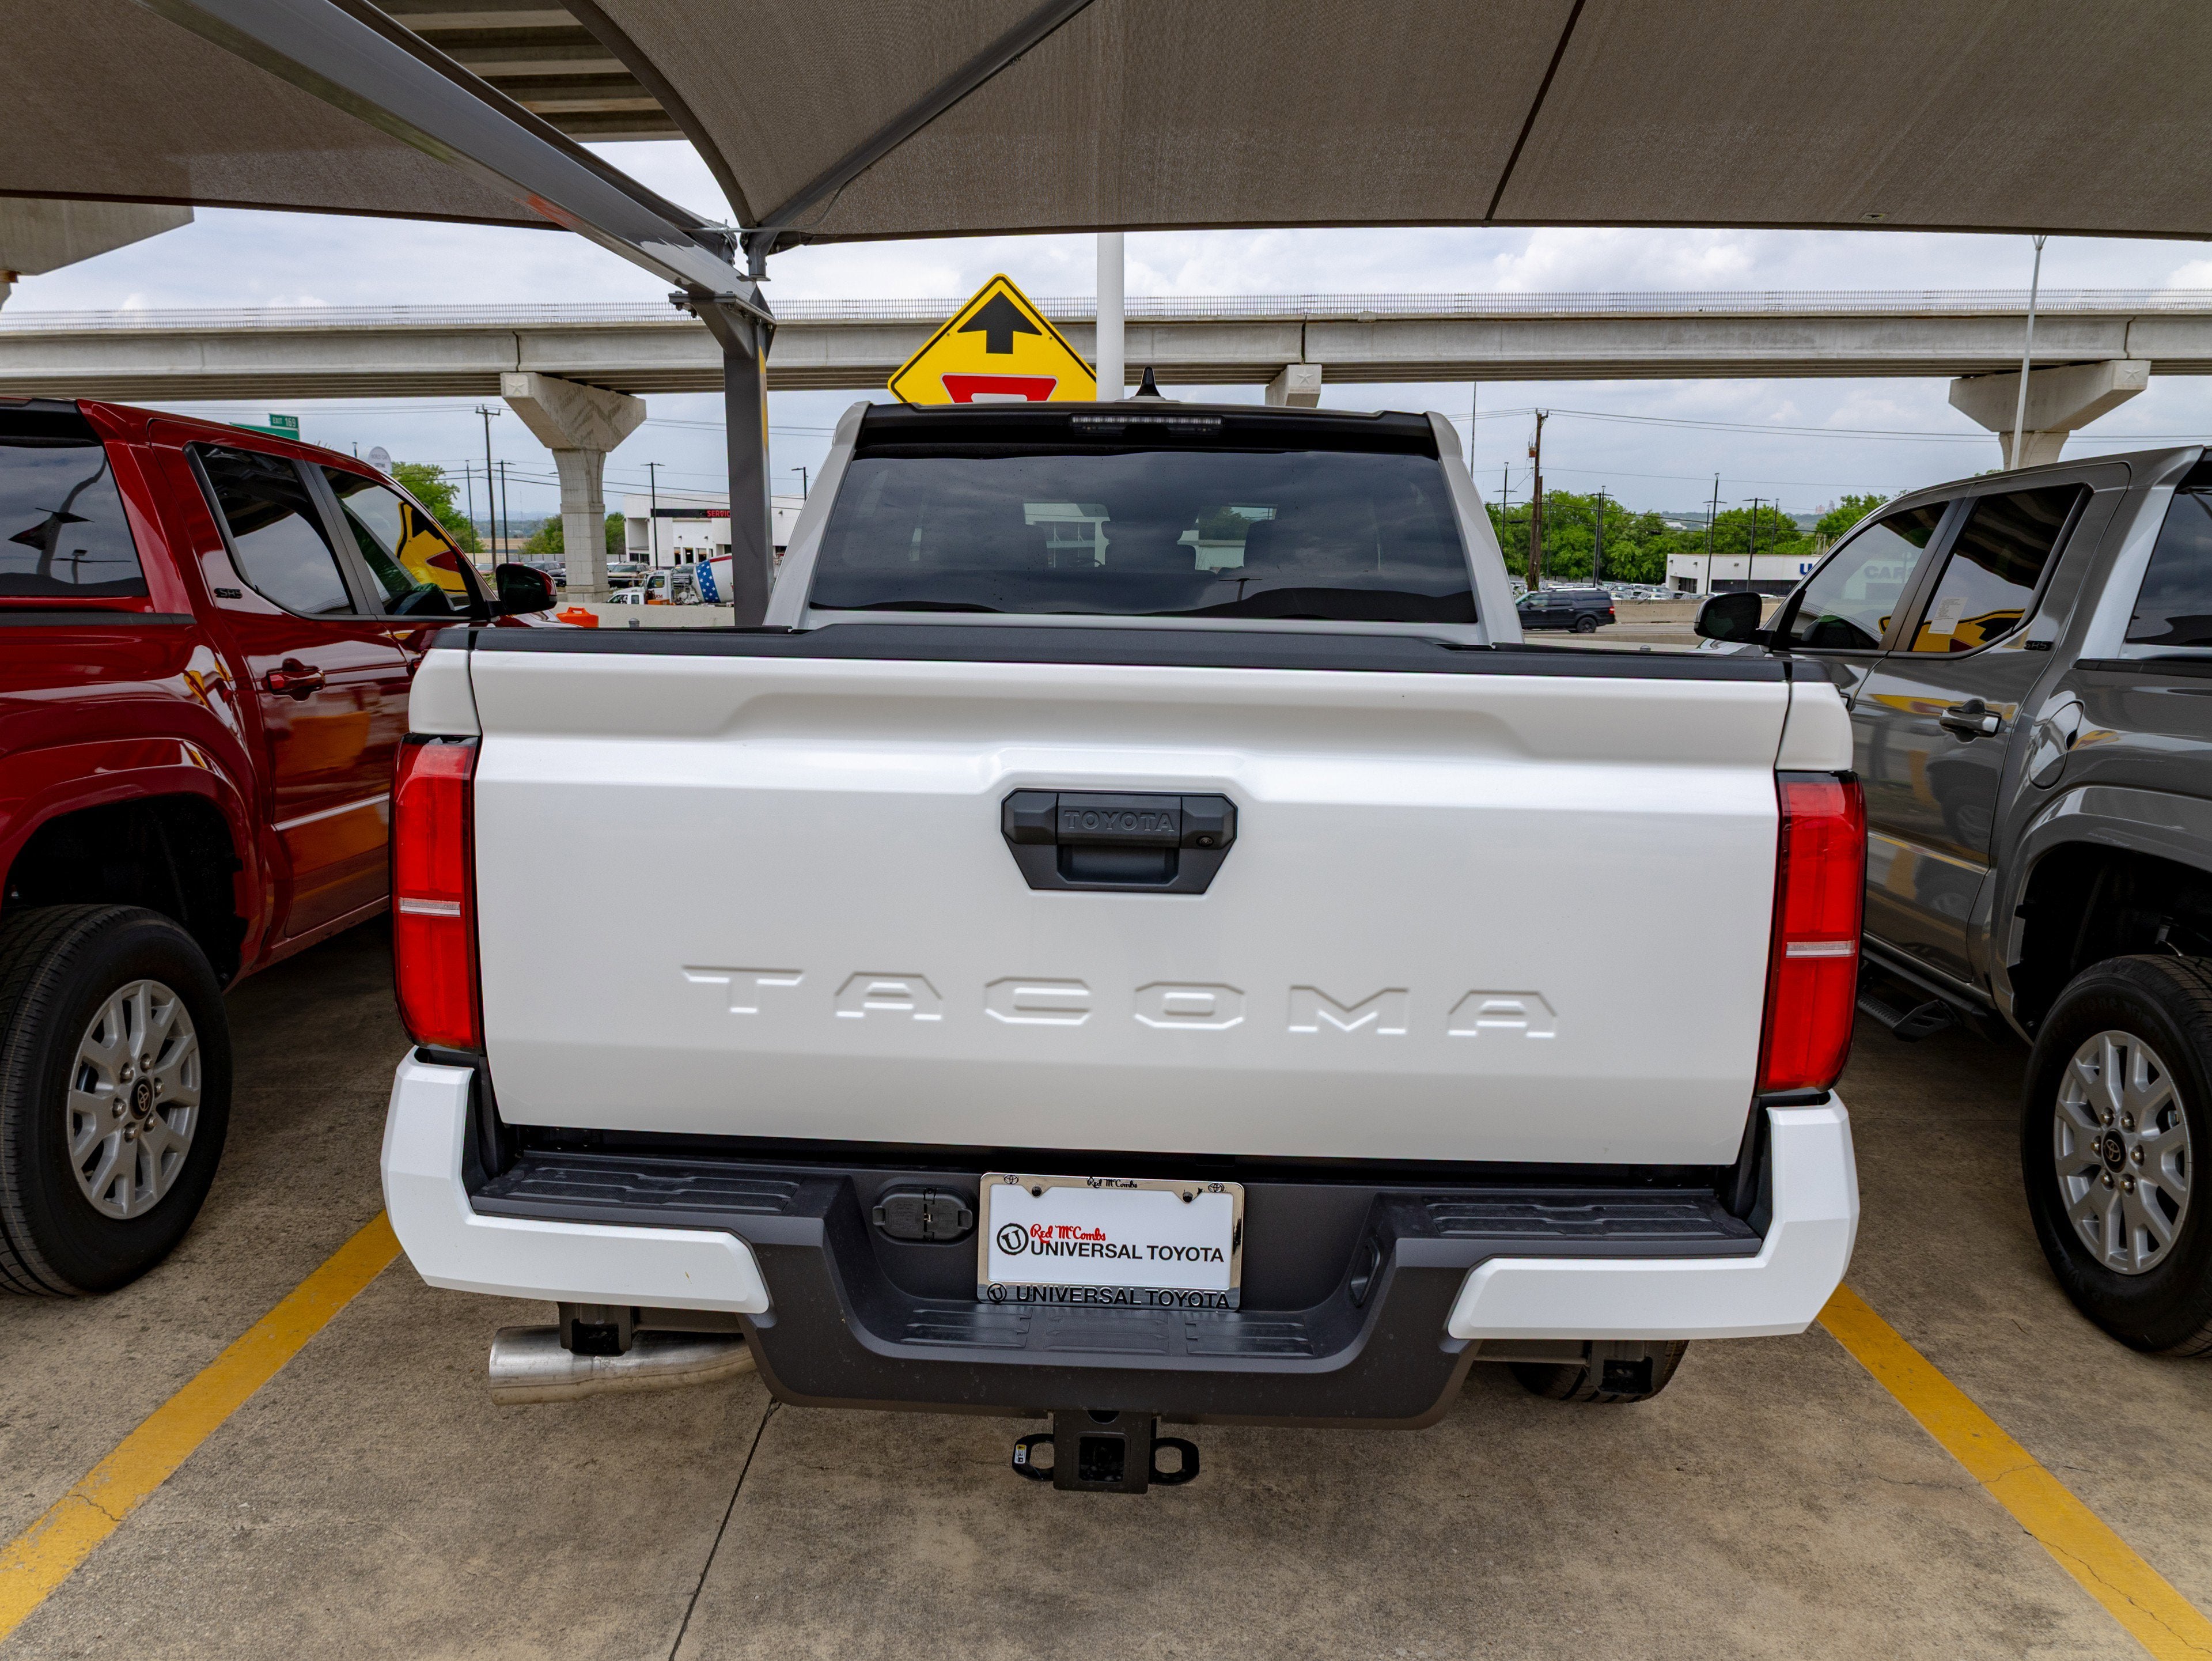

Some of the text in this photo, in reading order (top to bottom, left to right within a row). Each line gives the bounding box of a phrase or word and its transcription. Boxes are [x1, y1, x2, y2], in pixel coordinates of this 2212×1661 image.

[285, 417, 296, 427] 169
[1064, 810, 1175, 832] TOYOTA
[682, 964, 1558, 1039] TACOMA
[1087, 1177, 1137, 1189] Red McCombs
[1030, 1223, 1107, 1244] Red McCombs
[1031, 1240, 1142, 1259] UNIVERSAL
[1146, 1245, 1225, 1262] TOYOTA
[1016, 1284, 1142, 1305] UNIVERSAL
[1145, 1288, 1230, 1310] TOYOTA
